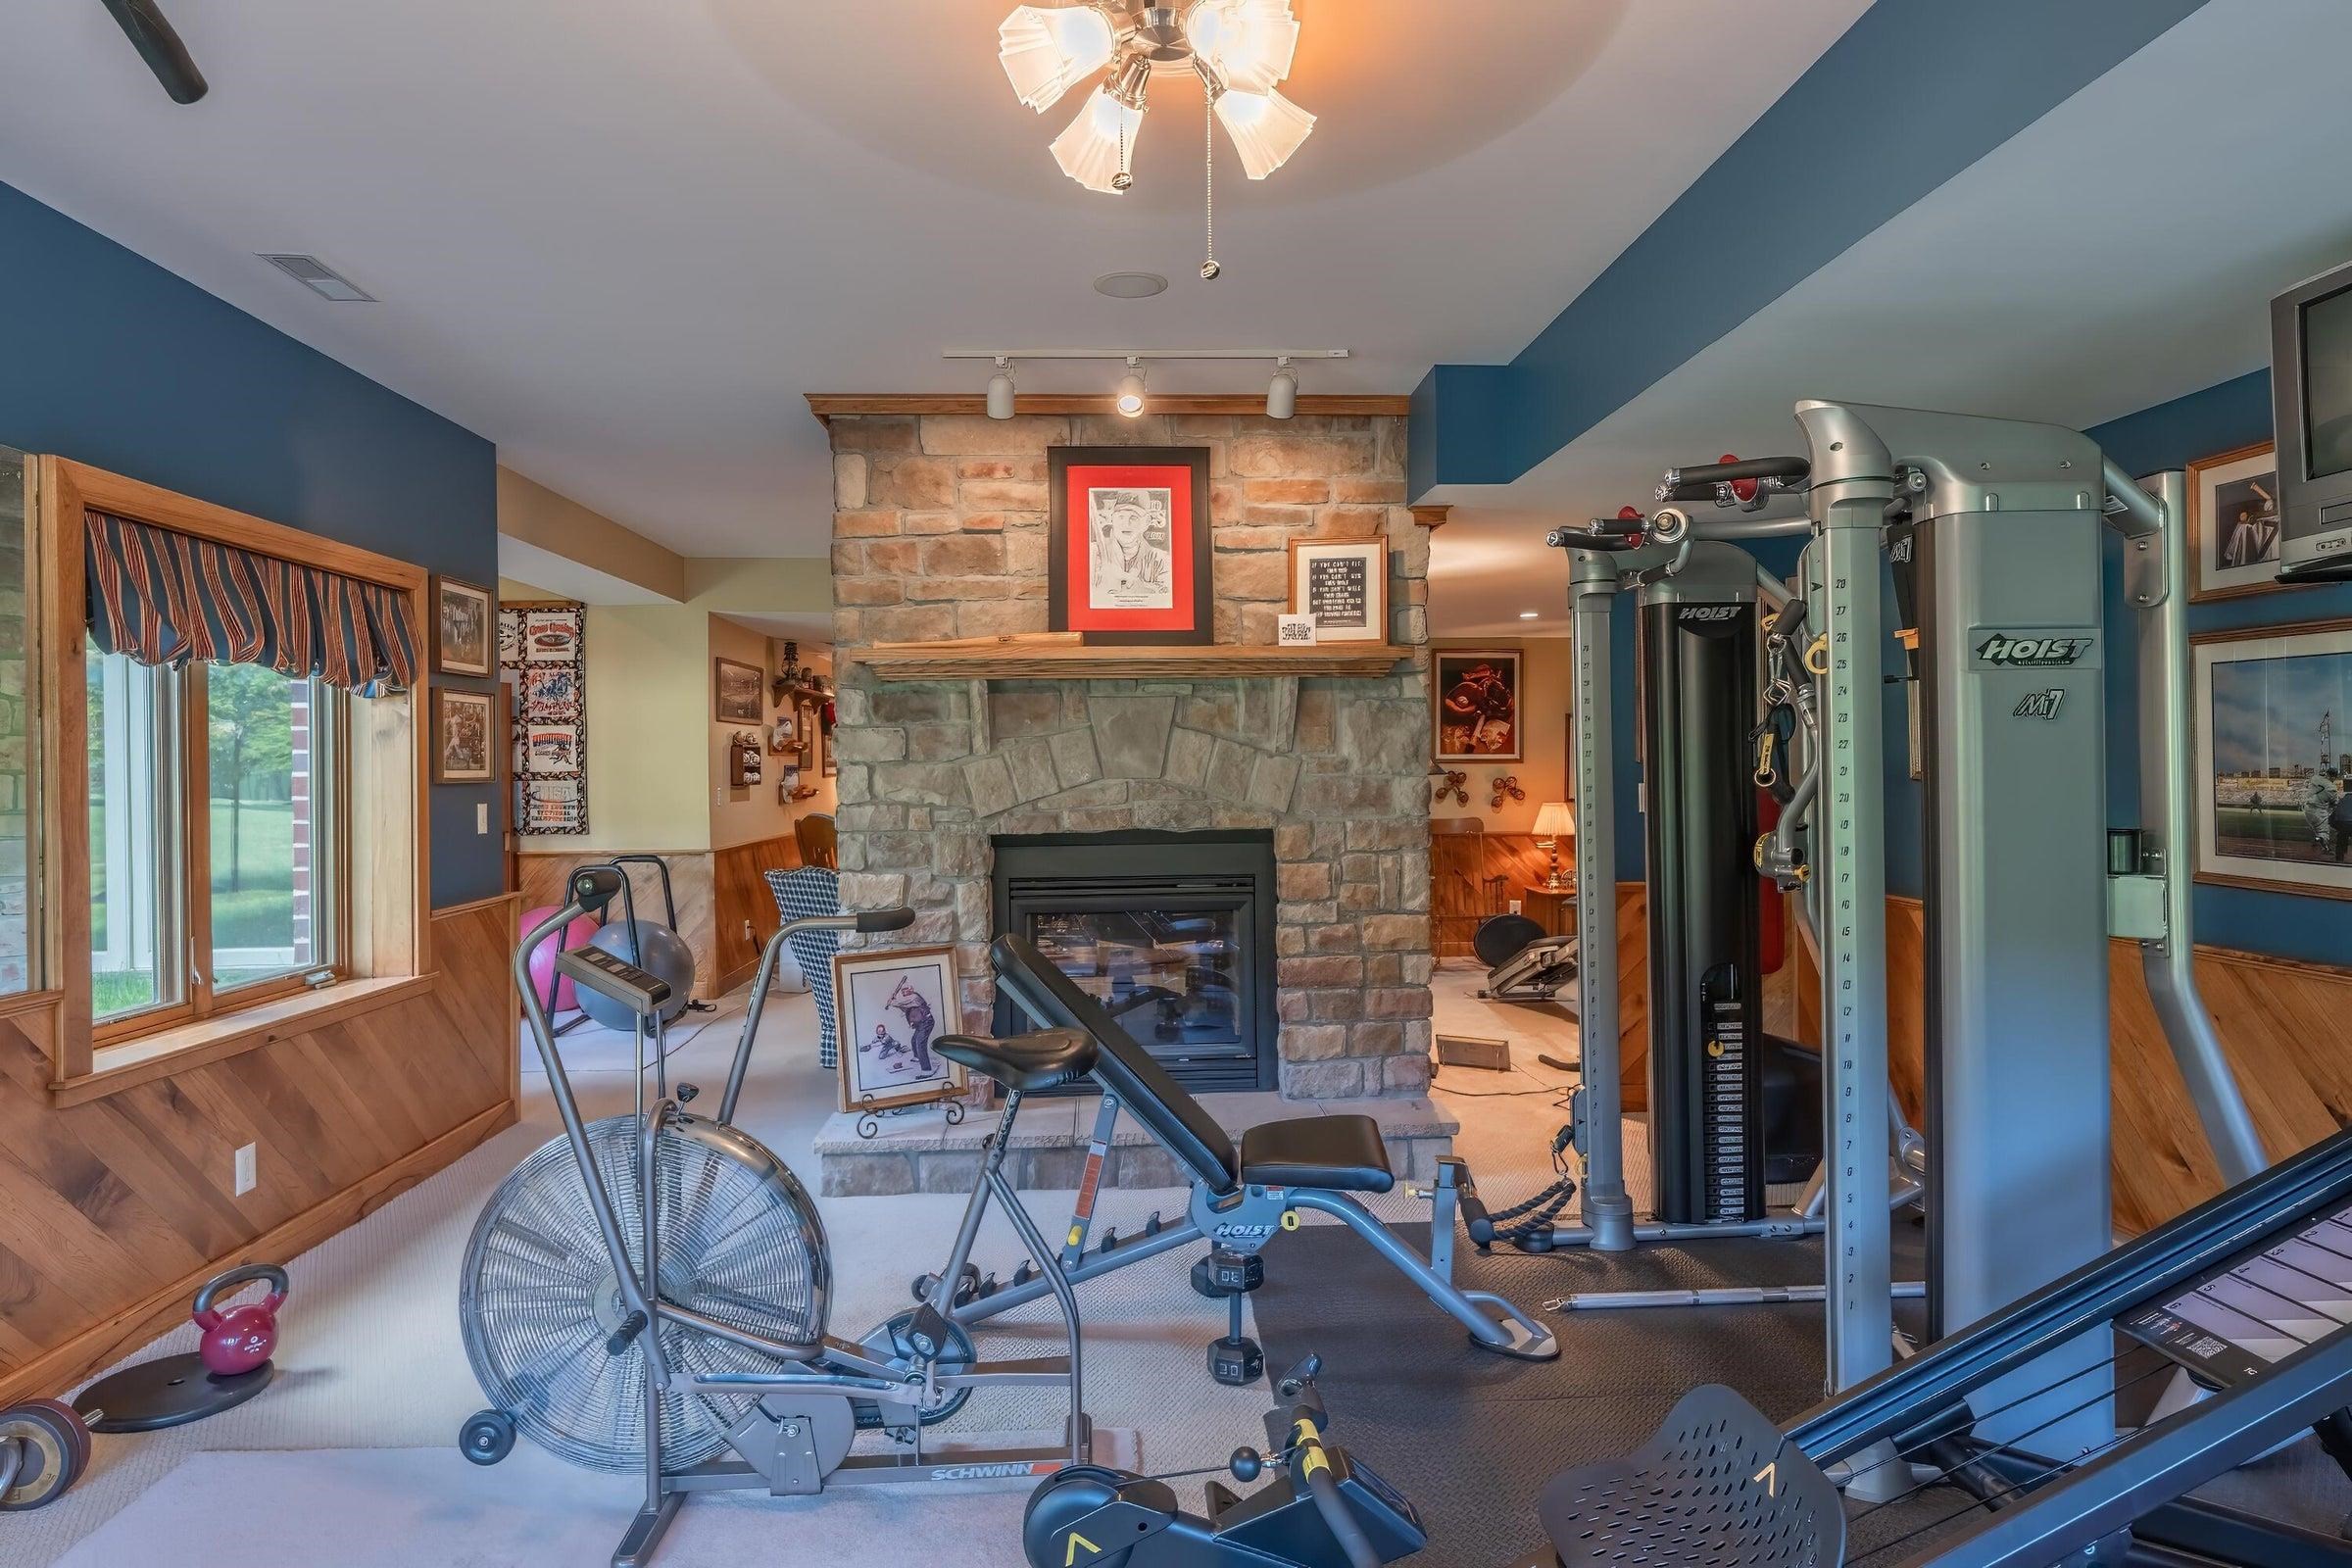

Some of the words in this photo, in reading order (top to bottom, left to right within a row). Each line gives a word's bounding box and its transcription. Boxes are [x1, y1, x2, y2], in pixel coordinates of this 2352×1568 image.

[1679, 606, 1741, 619] HOIST
[1837, 633, 1846, 642] 26
[1980, 638, 2094, 660] HOIST
[1837, 660, 1846, 669] 25
[1838, 686, 1847, 696] 24
[1839, 766, 1847, 776] 21
[1841, 847, 1849, 856] 18
[1842, 926, 1850, 936] 15
[1844, 1034, 1851, 1043] 11
[1215, 1224, 1275, 1237] HOIST
[1219, 1363, 1238, 1376] 30
[931, 1463, 1033, 1481] SCHWINN
